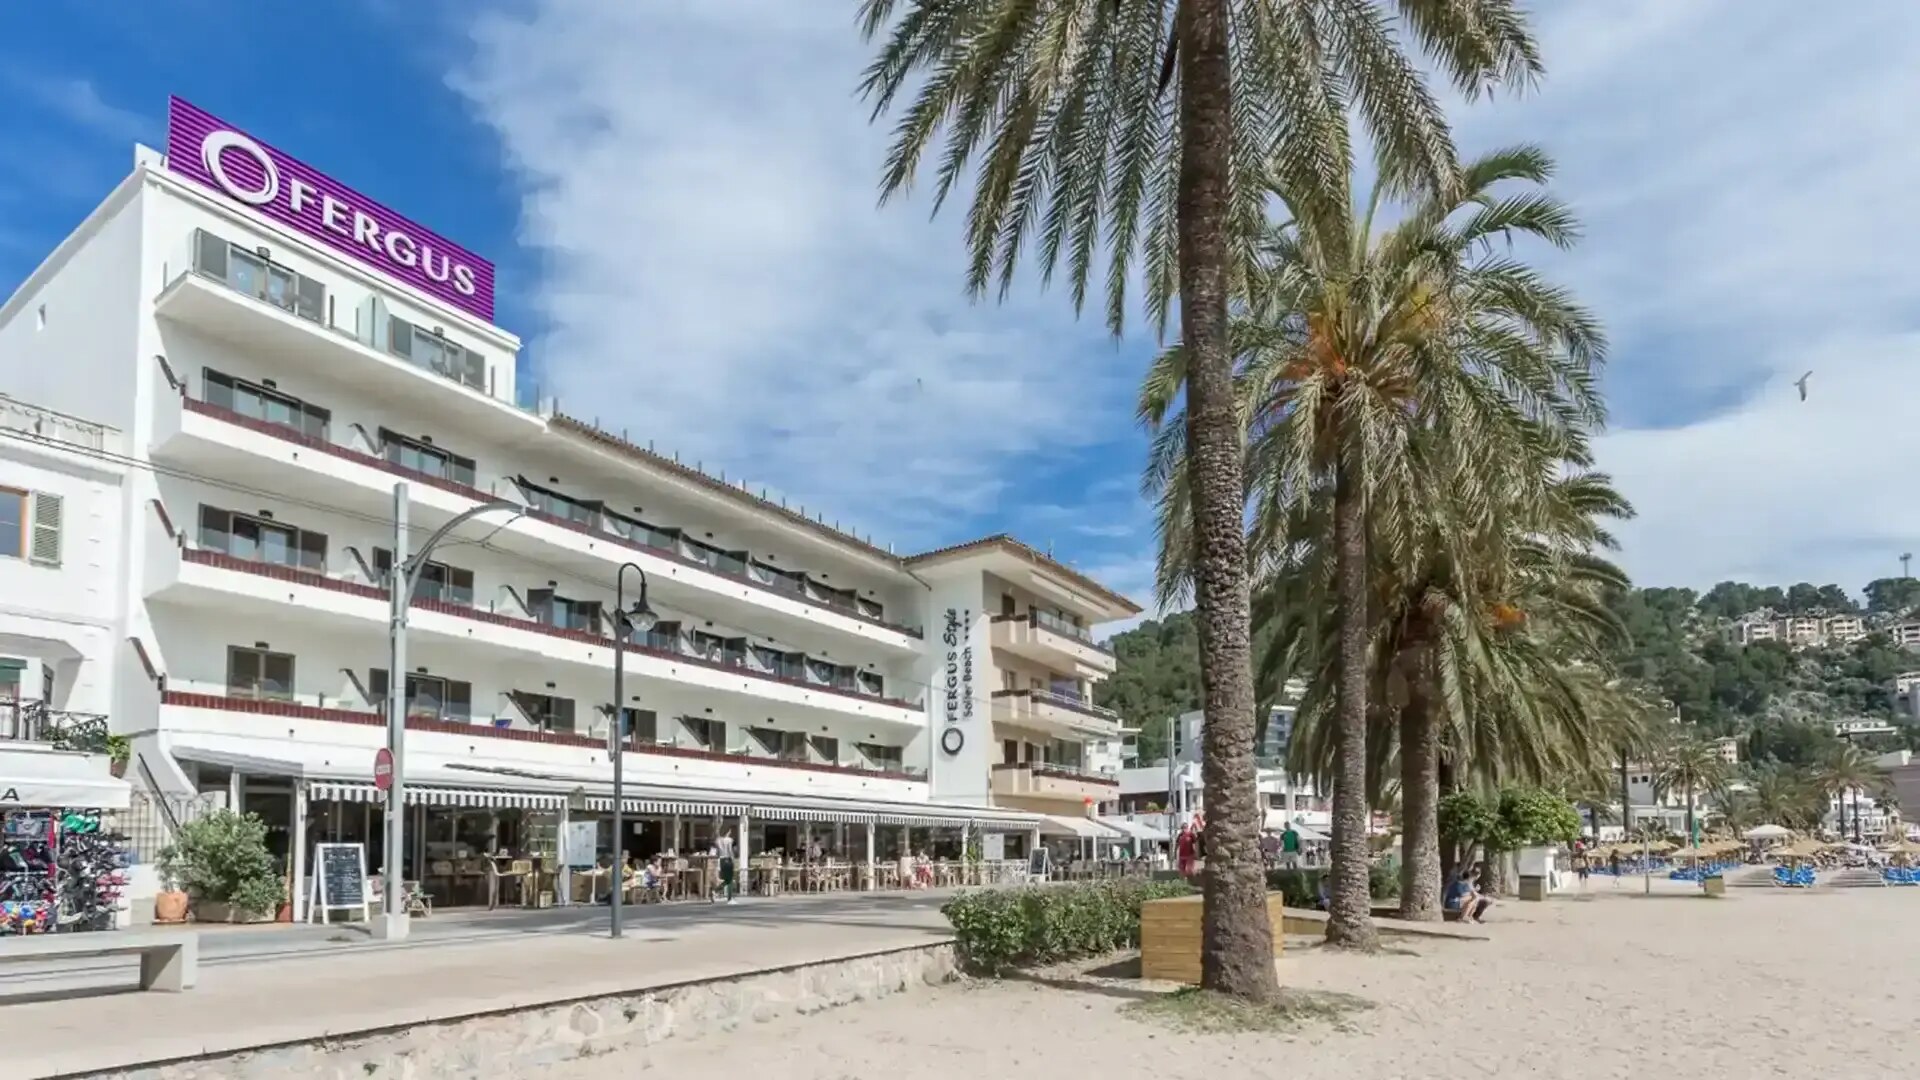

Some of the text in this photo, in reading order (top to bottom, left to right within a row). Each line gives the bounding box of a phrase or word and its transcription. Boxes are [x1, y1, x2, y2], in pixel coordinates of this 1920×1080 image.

[290, 178, 476, 296] FERGUS
[943, 608, 962, 722] FERGUS Style
[963, 647, 972, 682] Beach
